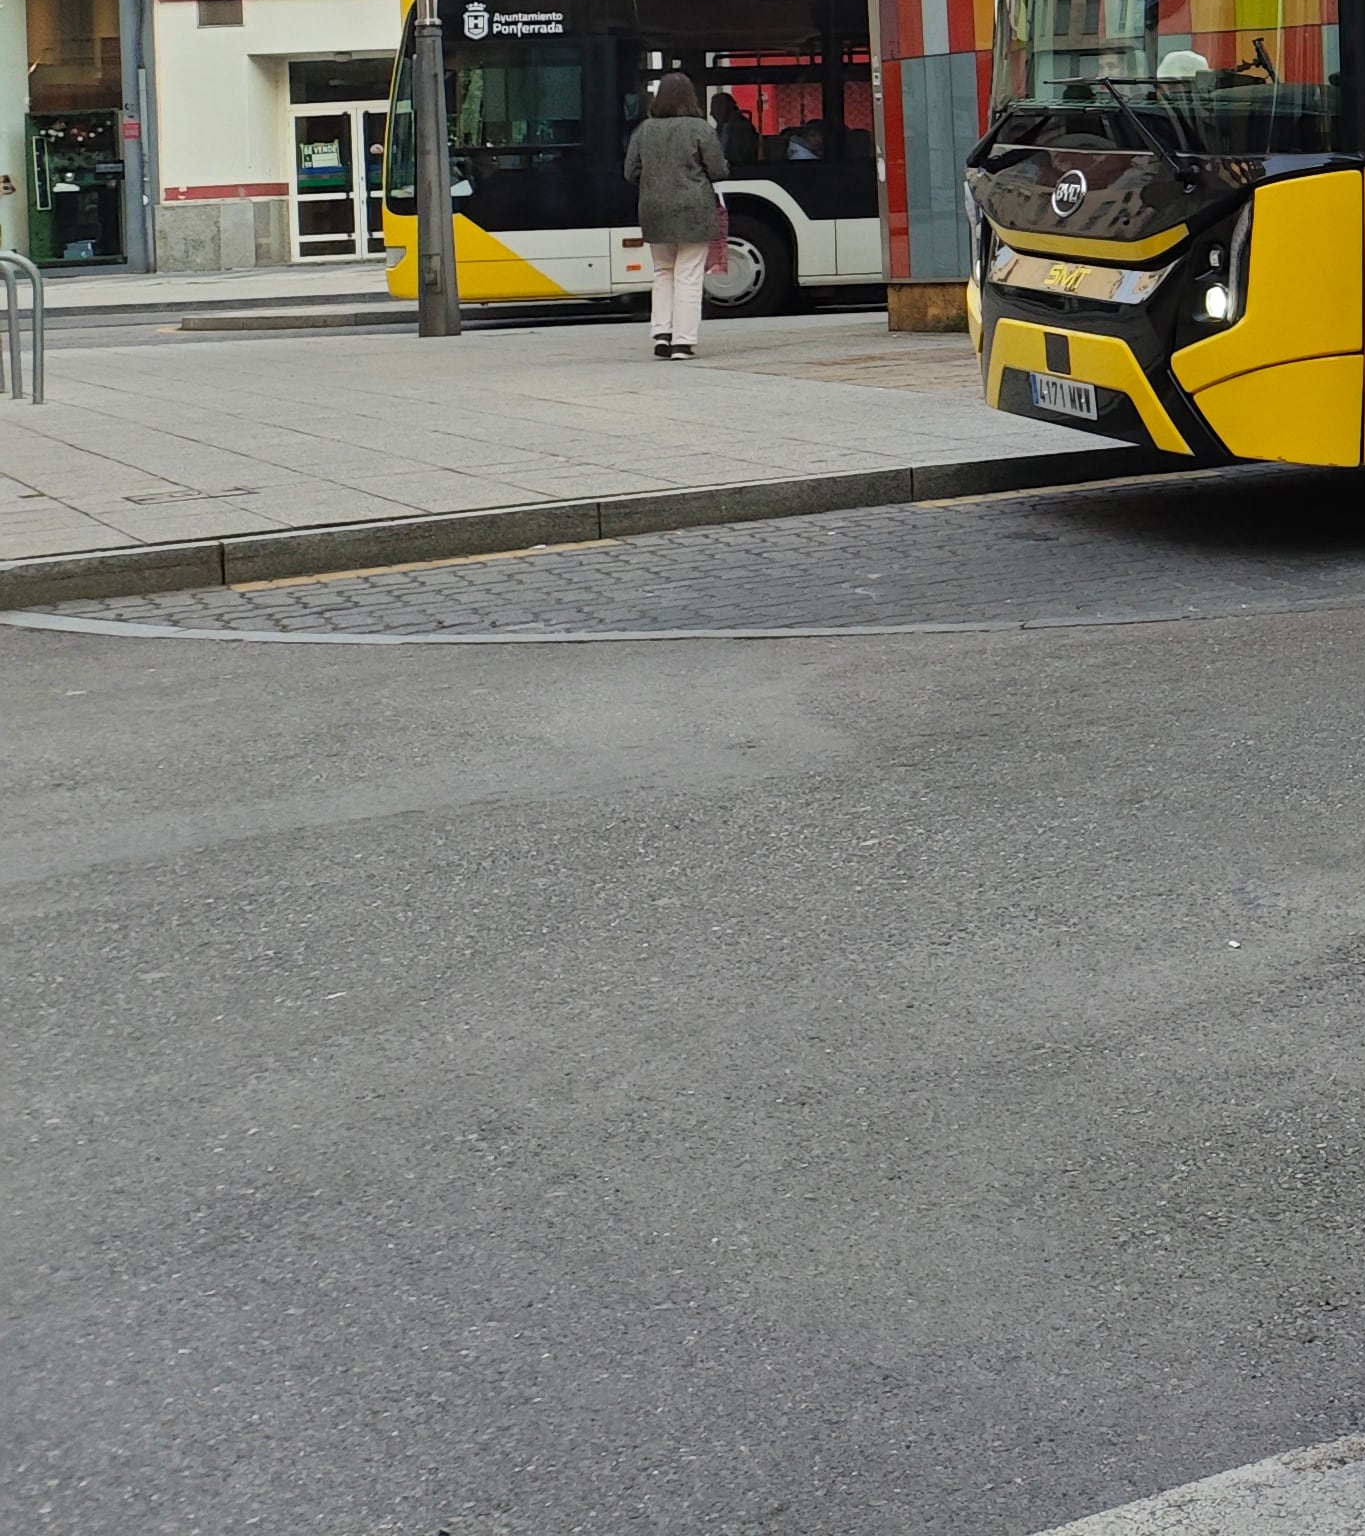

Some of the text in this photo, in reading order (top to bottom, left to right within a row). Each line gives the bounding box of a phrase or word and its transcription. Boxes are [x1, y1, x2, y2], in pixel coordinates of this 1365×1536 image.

[493, 11, 563, 24] Ayuntamiento
[493, 21, 564, 38] Ponferrada
[1056, 183, 1081, 203] BYD
[1043, 263, 1092, 289] SMT
[1039, 378, 1066, 409] 4171
